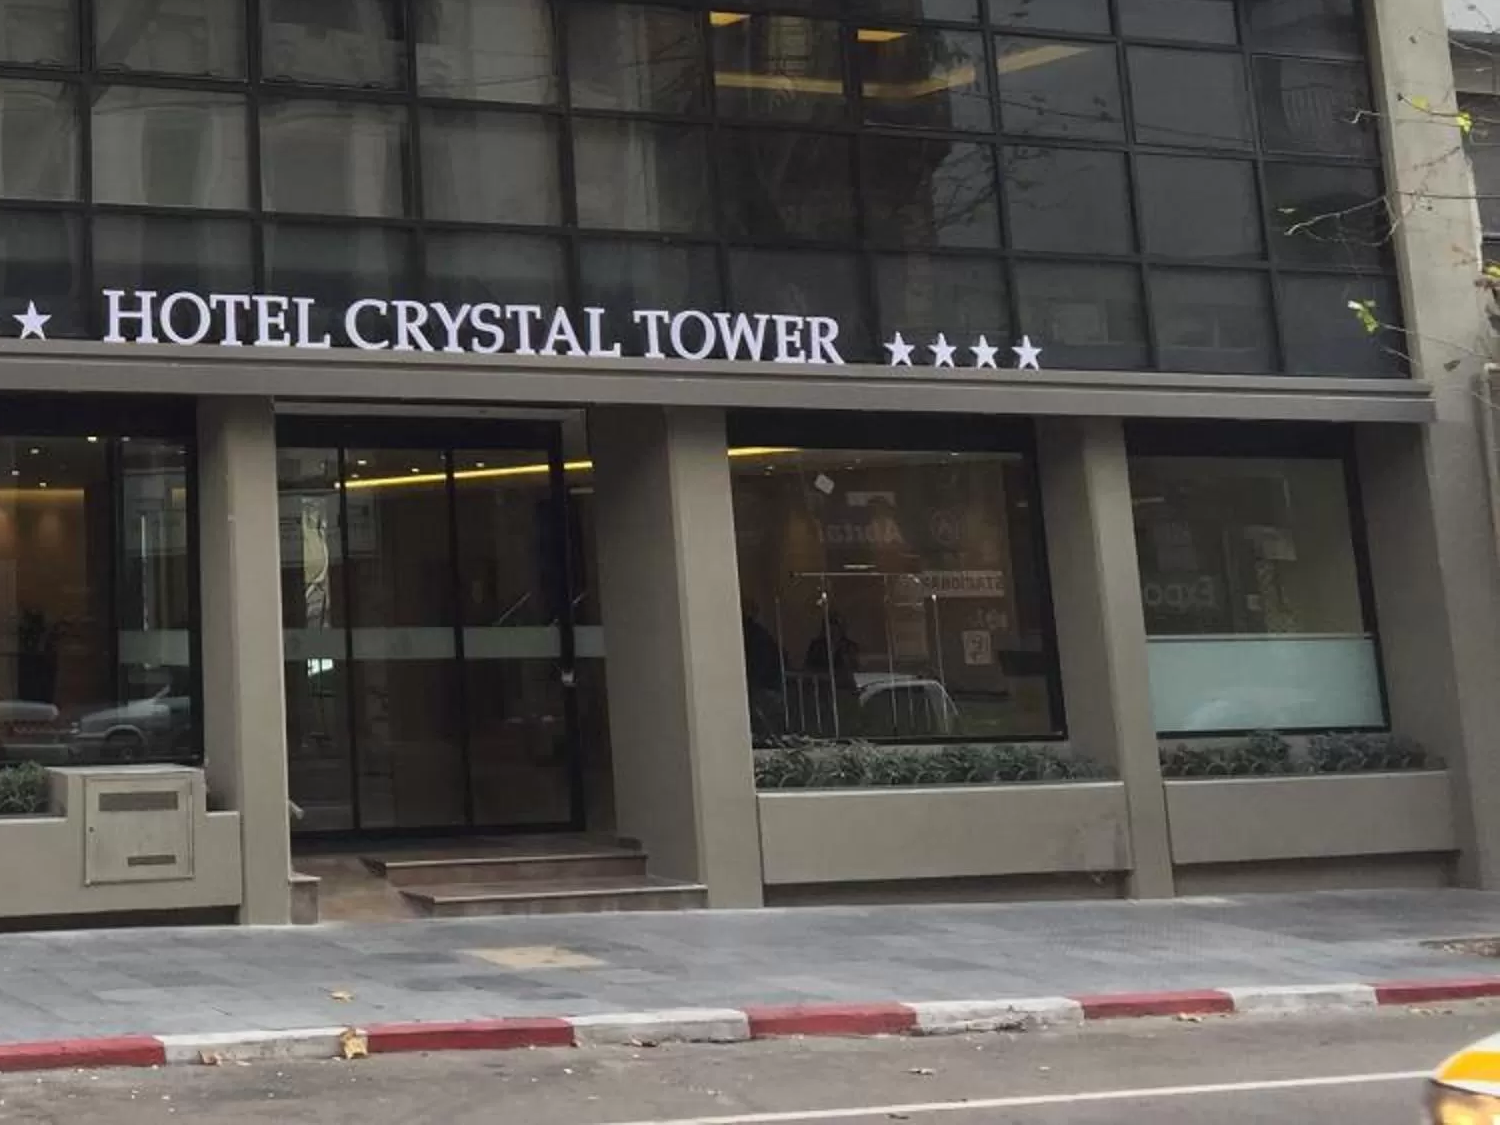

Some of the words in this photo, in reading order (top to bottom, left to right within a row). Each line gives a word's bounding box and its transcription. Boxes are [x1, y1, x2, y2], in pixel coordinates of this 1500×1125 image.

[102, 289, 331, 348] HOTEL
[345, 298, 621, 358] CRYSTAL
[633, 309, 845, 364] TOWER
